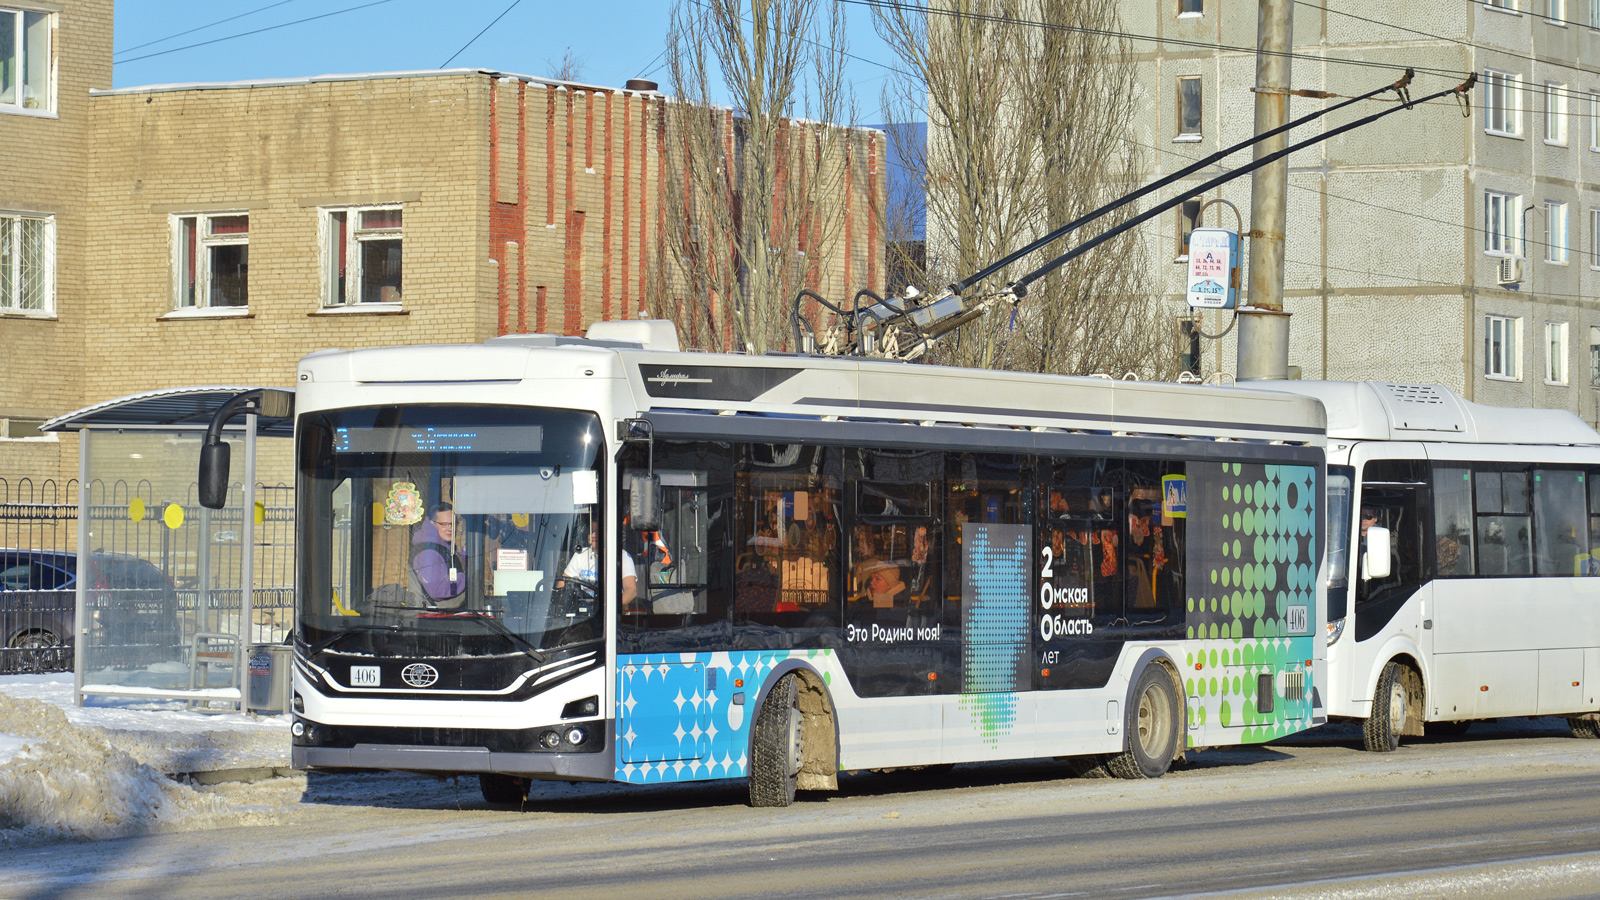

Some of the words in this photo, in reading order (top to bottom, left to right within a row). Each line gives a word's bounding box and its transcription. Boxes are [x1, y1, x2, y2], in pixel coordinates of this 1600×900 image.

[1041, 546, 1053, 577] 2
[1290, 608, 1305, 630] 406
[847, 623, 868, 642] Это
[871, 623, 914, 644] Родина
[917, 623, 941, 641] моя!
[1041, 651, 1060, 664] лет
[354, 668, 376, 684] 406
